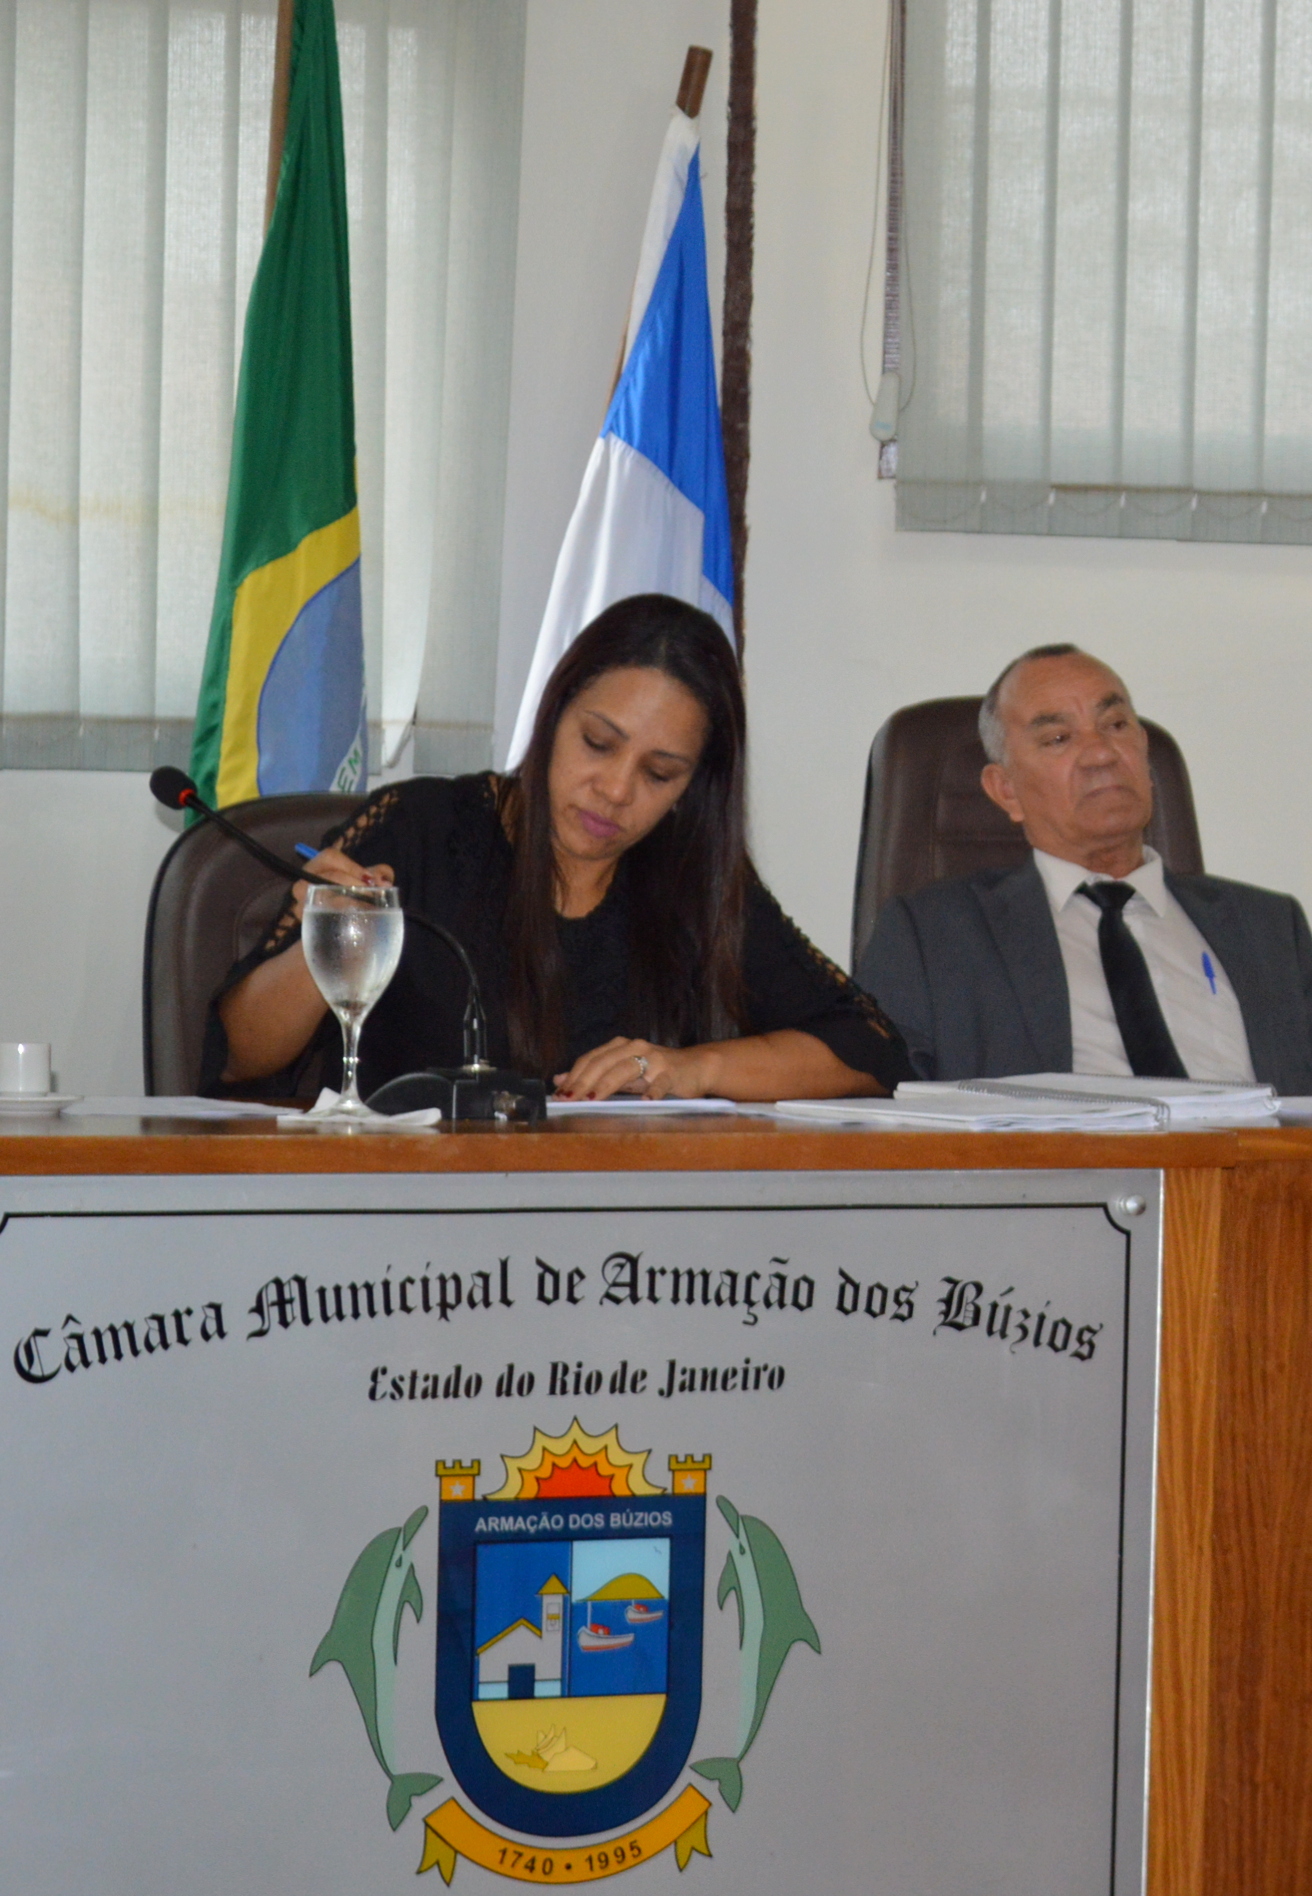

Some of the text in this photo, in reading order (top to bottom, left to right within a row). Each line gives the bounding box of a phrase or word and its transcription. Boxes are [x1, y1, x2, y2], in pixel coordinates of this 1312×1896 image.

[13, 1251, 1104, 1384] Câmara Municipal de Armação dos Búzios
[367, 1357, 785, 1401] Estado do Rio de Janeiro
[475, 1508, 673, 1533] ARMAÇÃO DOS BÚZIOS
[498, 1840, 642, 1876] 1740 1995
